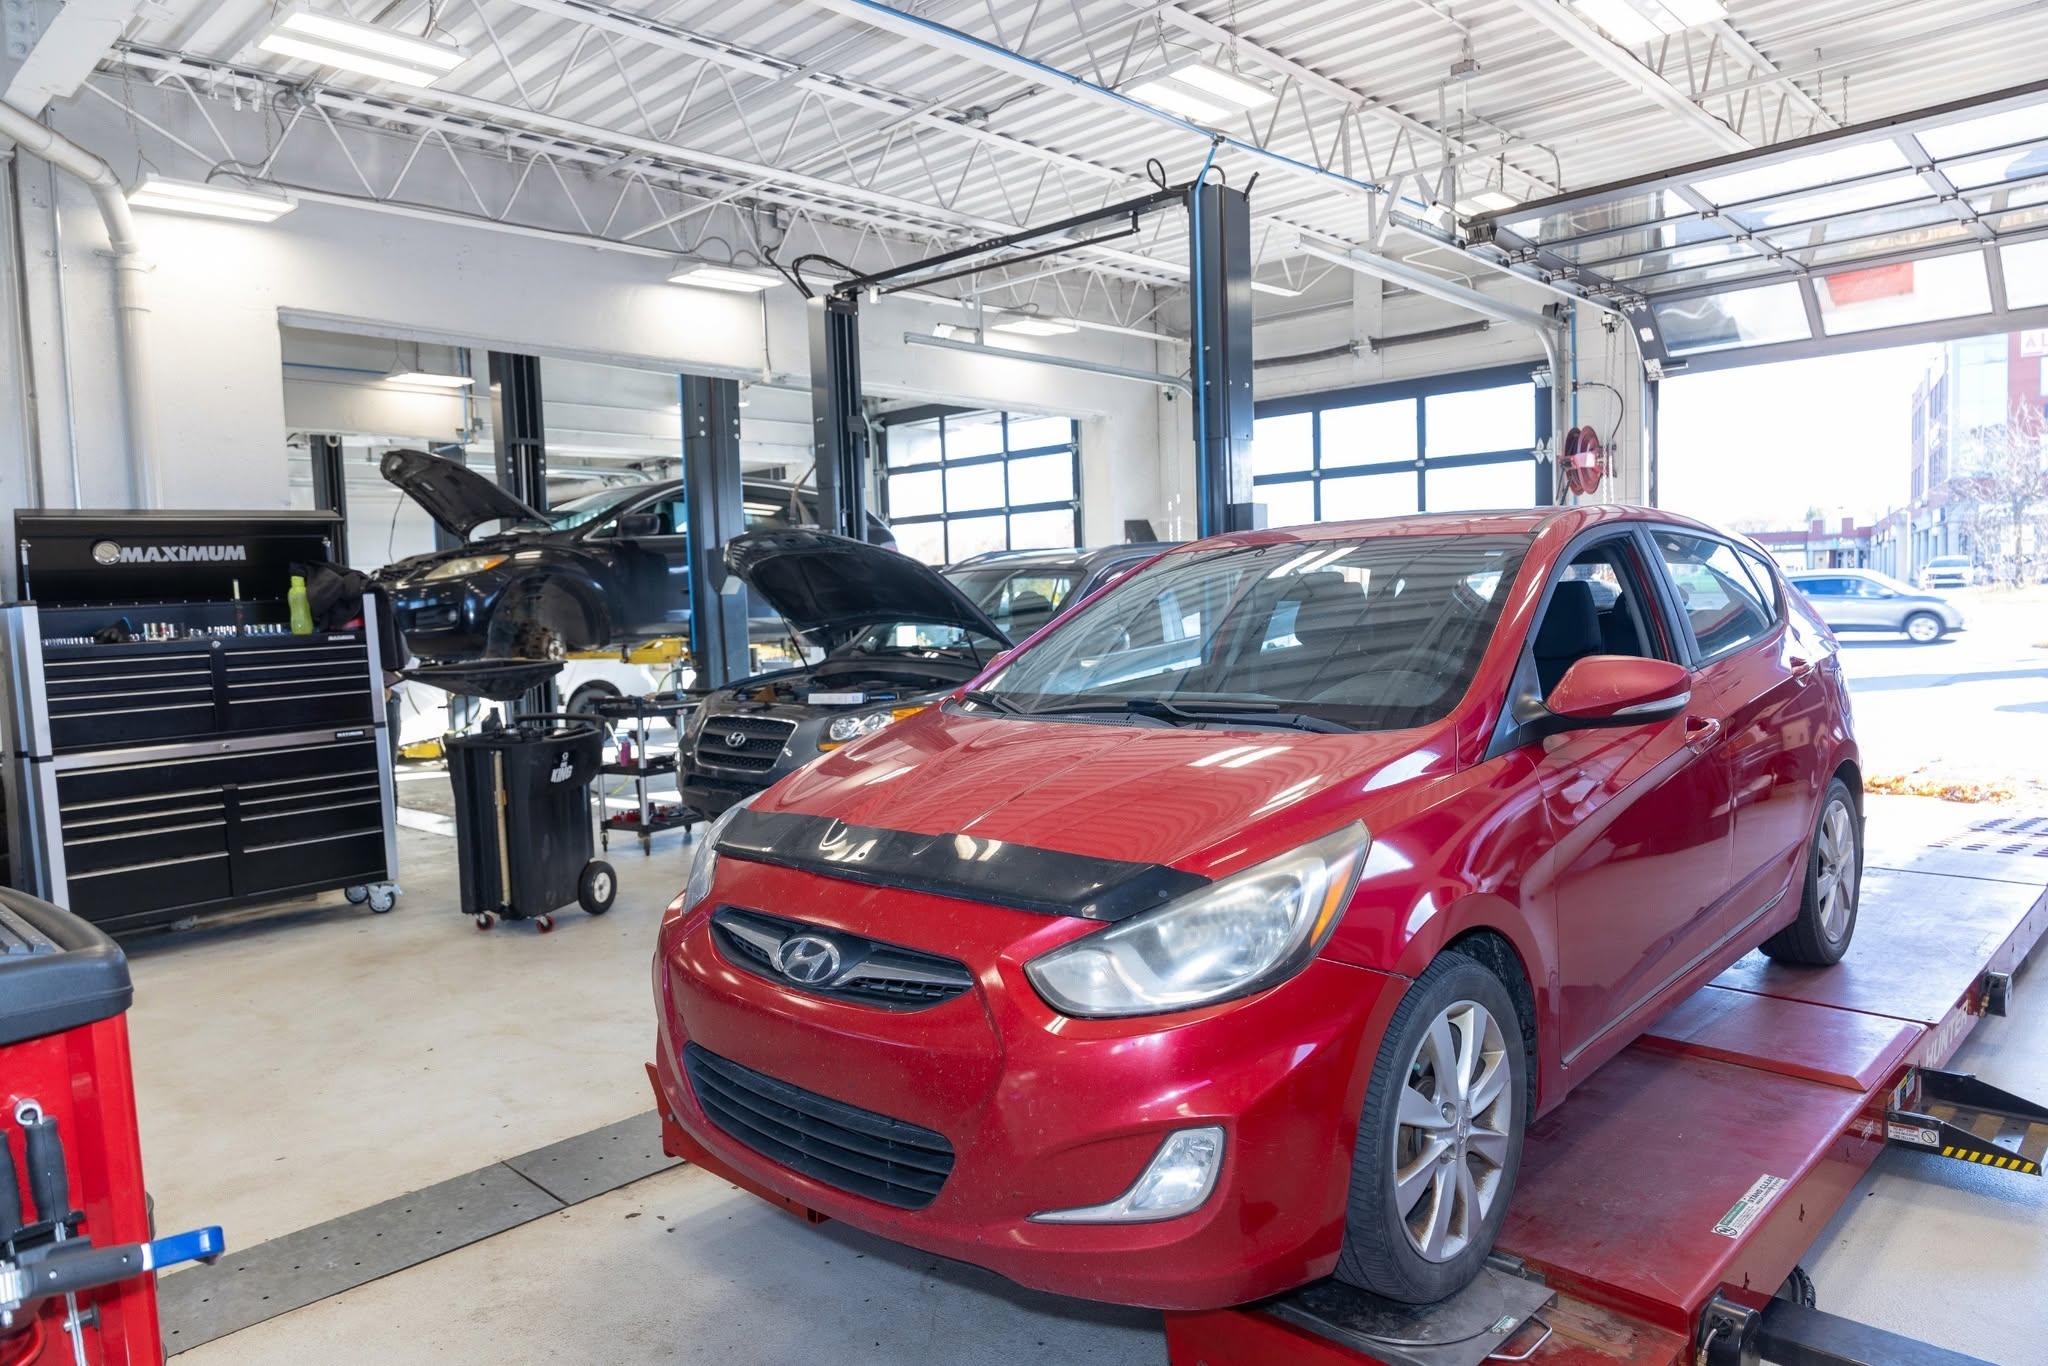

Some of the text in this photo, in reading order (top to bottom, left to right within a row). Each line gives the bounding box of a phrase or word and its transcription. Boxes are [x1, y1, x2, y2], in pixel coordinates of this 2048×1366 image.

[120, 545, 247, 563] MAXIMUM
[550, 765, 573, 783] KING
[1926, 1004, 1968, 1068] HUNTER
[1747, 1188, 1764, 1203] STAND
